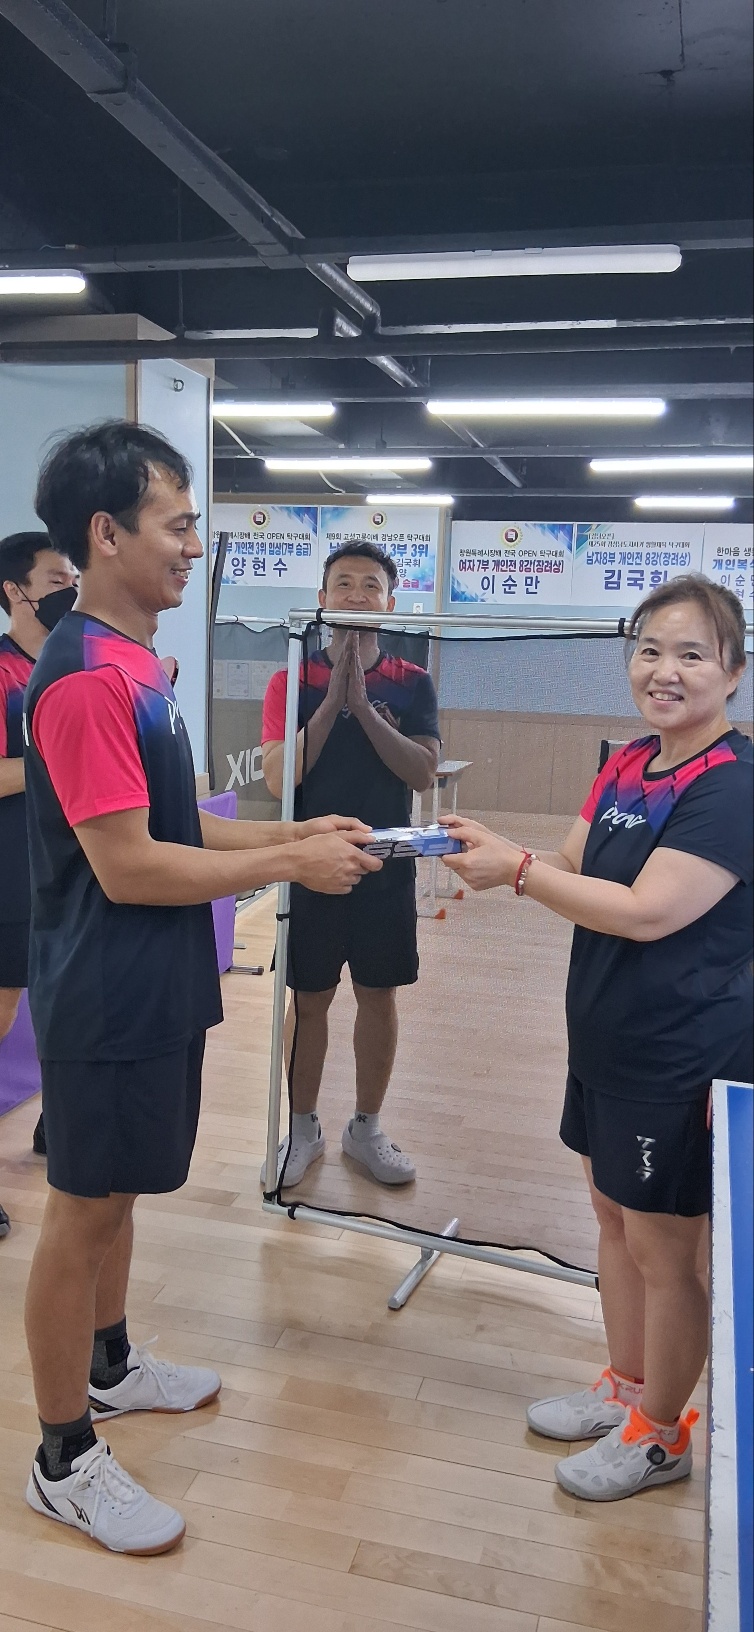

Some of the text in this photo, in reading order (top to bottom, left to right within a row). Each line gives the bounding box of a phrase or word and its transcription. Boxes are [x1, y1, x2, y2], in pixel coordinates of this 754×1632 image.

[266, 532, 285, 540] OPEN
[234, 541, 254, 555] 개인전
[255, 541, 267, 556] 3위
[389, 543, 408, 558] 3부
[410, 543, 429, 558] 3위
[503, 549, 516, 558] 전국
[518, 549, 538, 558] OPEN
[539, 549, 565, 558] 탁구대회
[716, 546, 741, 557] 한마음
[618, 551, 643, 566] 개인전
[491, 559, 517, 573] 개인전
